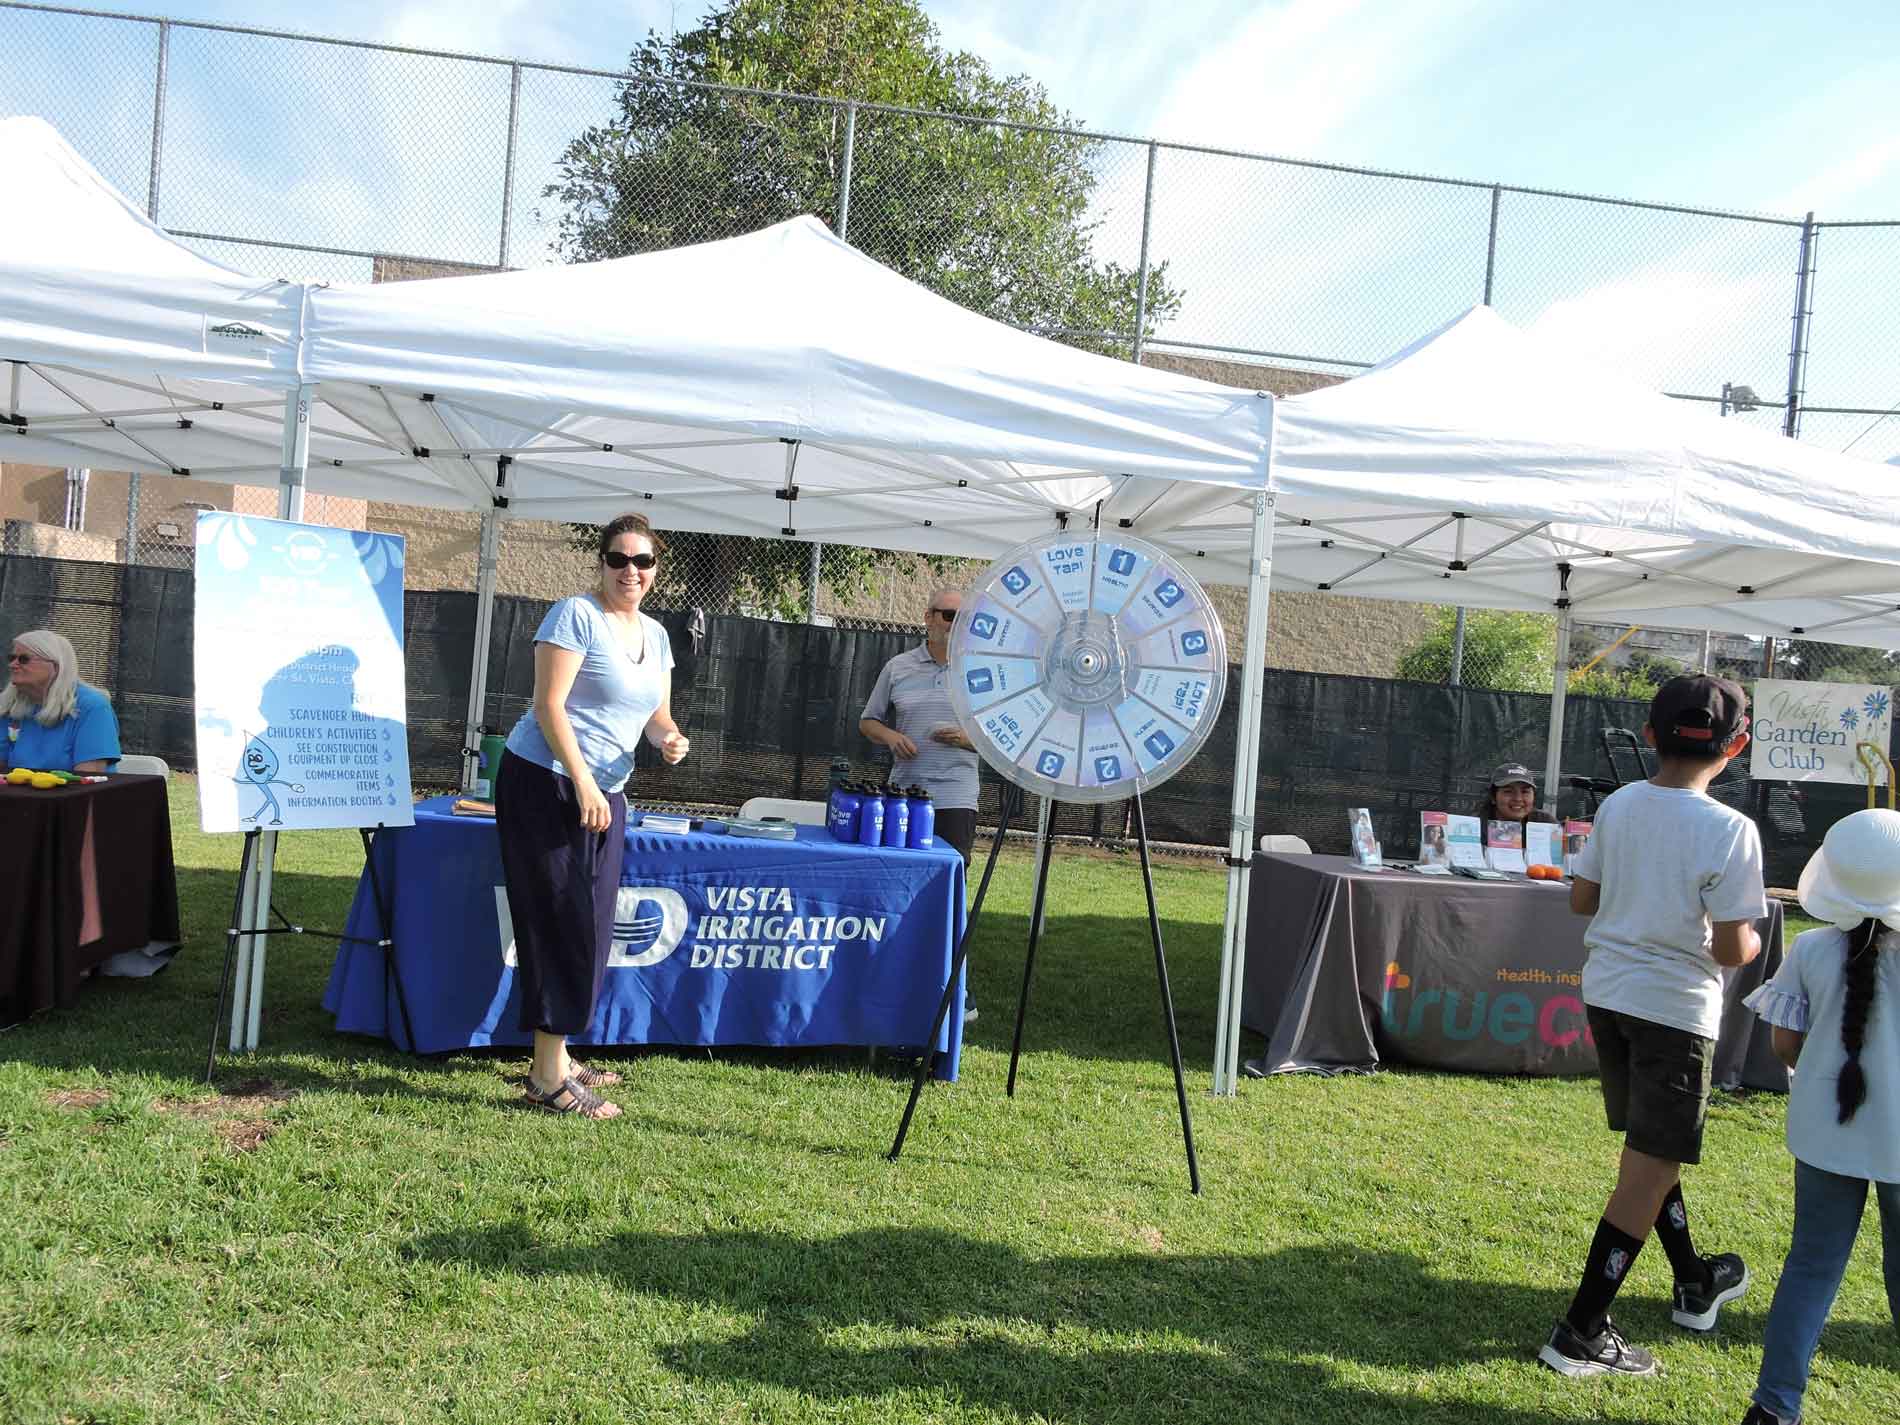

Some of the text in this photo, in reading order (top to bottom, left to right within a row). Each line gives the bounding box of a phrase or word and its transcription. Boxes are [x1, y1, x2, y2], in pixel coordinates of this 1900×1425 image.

[266, 726, 377, 740] CHILDREN'S ACTIVITIES
[1754, 718, 1847, 746] Garden
[296, 743, 378, 754] SEE CONSTRUCTION
[288, 754, 379, 765] EQUIPMENT UP CLOSE
[1768, 746, 1825, 771] Club
[305, 769, 380, 780] COMMEMORATIVE
[287, 795, 383, 808] INFORMATION BOOTHS
[706, 886, 793, 912] VISTA
[695, 915, 887, 942] IRRIGATION
[690, 944, 836, 969] DISTRICT
[1496, 968, 1552, 984] Health
